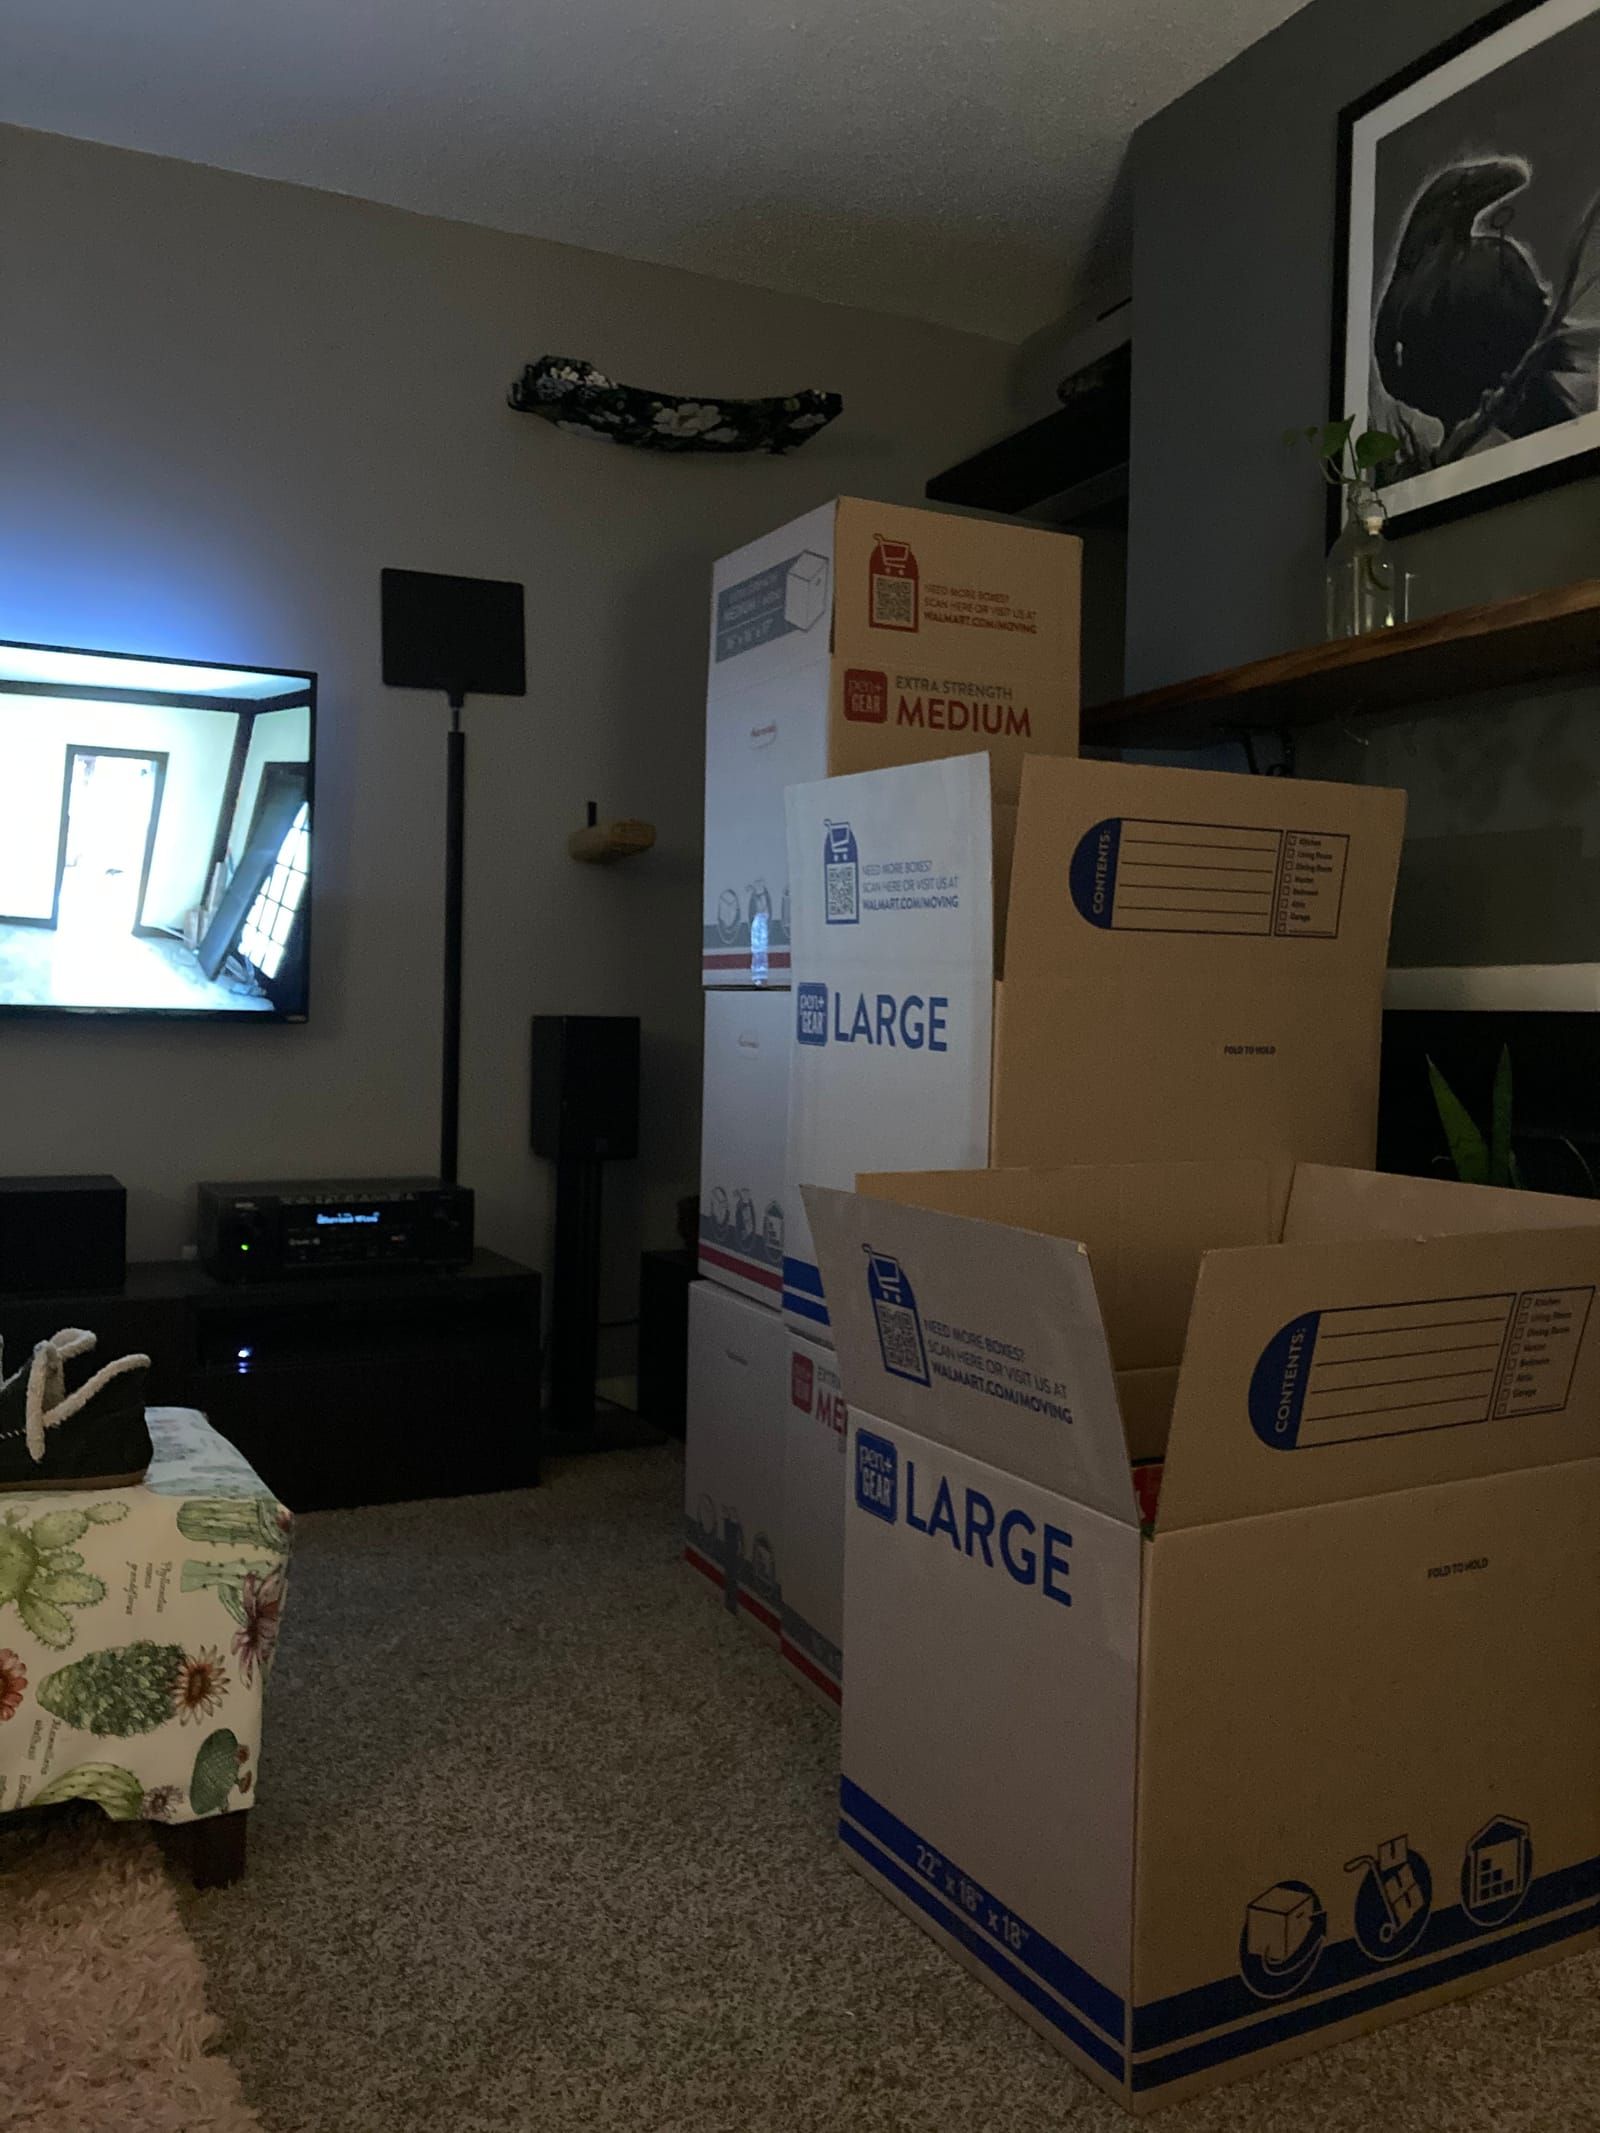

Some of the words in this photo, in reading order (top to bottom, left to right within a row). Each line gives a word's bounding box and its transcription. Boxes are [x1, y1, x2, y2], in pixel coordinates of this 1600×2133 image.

[951, 588, 976, 600] MORE
[924, 597, 949, 609] SCAN
[951, 601, 973, 612] HERE
[974, 604, 989, 614] OR
[991, 606, 1011, 617] VISIT
[1013, 609, 1025, 619] US
[1026, 610, 1038, 620] AT
[924, 610, 1037, 634] WALMART.COM/MOVING
[896, 675, 941, 693] EXTRA
[943, 681, 1013, 700] STRENGTH
[850, 693, 882, 714] GEAR
[897, 695, 1032, 739] MEDIUM
[863, 863, 881, 876] NEED
[882, 862, 904, 874] MORE
[1092, 830, 1112, 916] CONTENTS:
[863, 881, 881, 893] SCAN
[883, 879, 901, 891] HERE
[902, 879, 915, 891] OR
[916, 878, 934, 890] VISIT
[935, 877, 947, 889] US
[947, 875, 959, 888] AT
[863, 896, 959, 911] WALMART.COM/MOVING
[800, 993, 825, 1011] pen+
[801, 1009, 826, 1035] GEAR
[834, 991, 949, 1052] LARGE
[1223, 1045, 1243, 1056] FOLD
[1245, 1045, 1255, 1056] TO
[1256, 1045, 1276, 1056] HOLD
[924, 1319, 952, 1338] NEED
[953, 1328, 985, 1350] MORE
[985, 1338, 1025, 1363] BOXES?
[928, 1339, 957, 1361] SCAN
[957, 1350, 985, 1372] HERE
[986, 1360, 1005, 1377] OR
[1004, 1366, 1032, 1389] VISIT
[1034, 1376, 1051, 1394] US
[1053, 1381, 1068, 1399] AT
[1275, 1327, 1307, 1433] CONTENTS:
[931, 1360, 1073, 1425] WALMART.COM/MOVING
[860, 1446, 894, 1475] pen+
[862, 1470, 893, 1508] GEAR
[906, 1460, 1073, 1608] LARGE
[1428, 1565, 1451, 1579] FOLD
[1452, 1562, 1464, 1574] TO
[1465, 1557, 1489, 1571] HOLD
[916, 1843, 943, 1879] 22"
[959, 1879, 985, 1912] 18"
[1001, 1914, 1031, 1950] 18"
